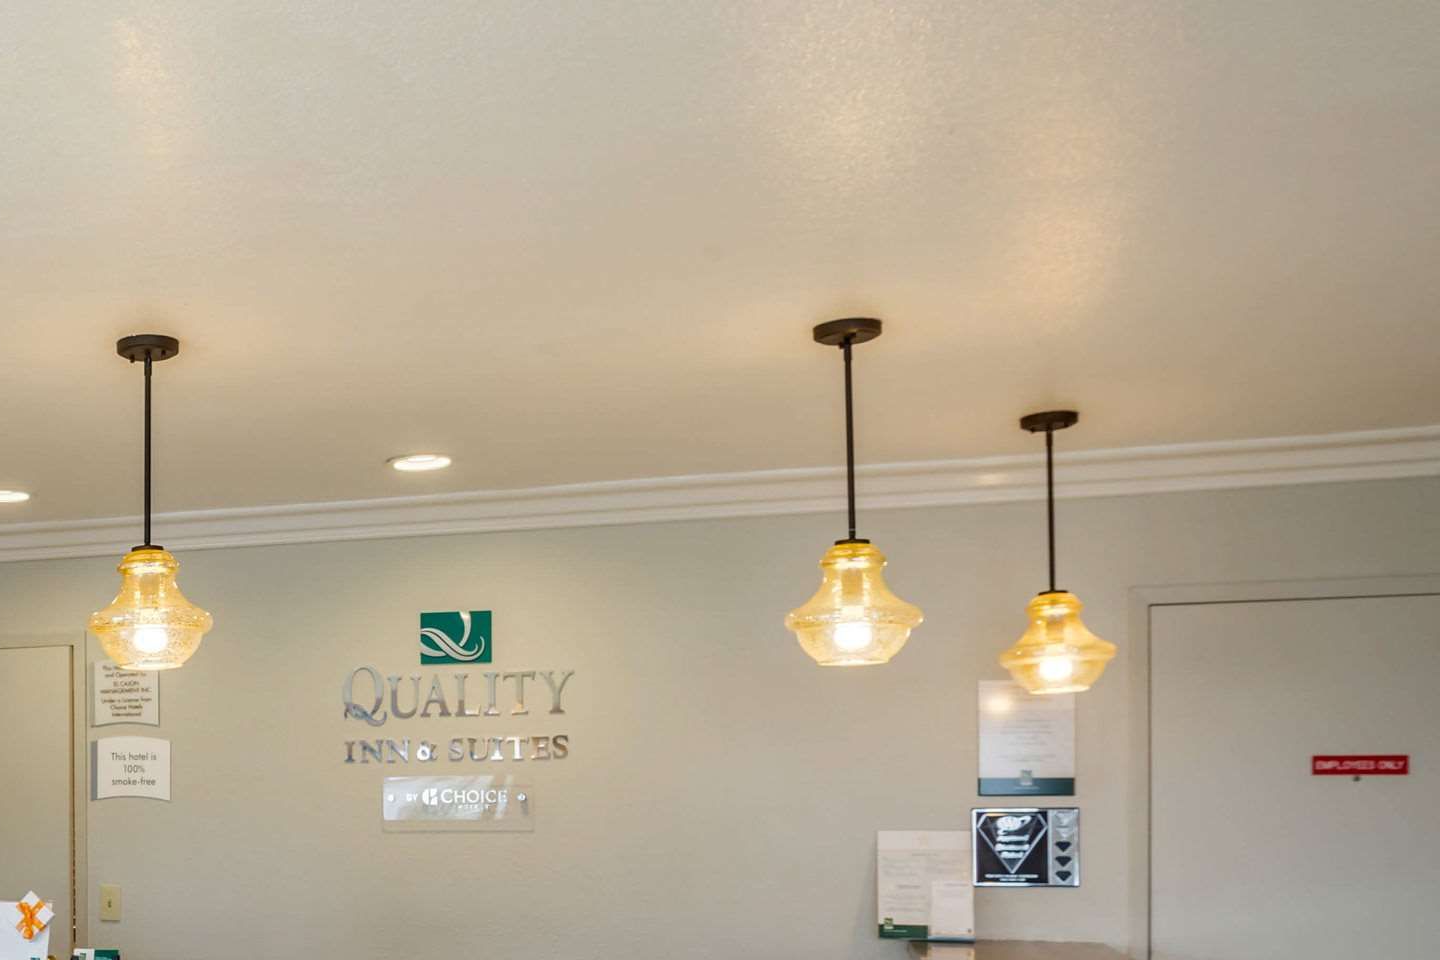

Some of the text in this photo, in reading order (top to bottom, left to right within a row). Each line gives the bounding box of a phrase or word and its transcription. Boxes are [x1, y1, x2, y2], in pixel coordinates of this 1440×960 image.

[343, 667, 575, 727] QUALITY
[344, 734, 569, 764] INN & SUITES
[111, 751, 126, 761] This
[128, 751, 148, 761] hotel
[1315, 760, 1405, 770] EMPLOYEES ONLY
[111, 776, 156, 786] smoke-free
[441, 788, 508, 804] CHOICE
